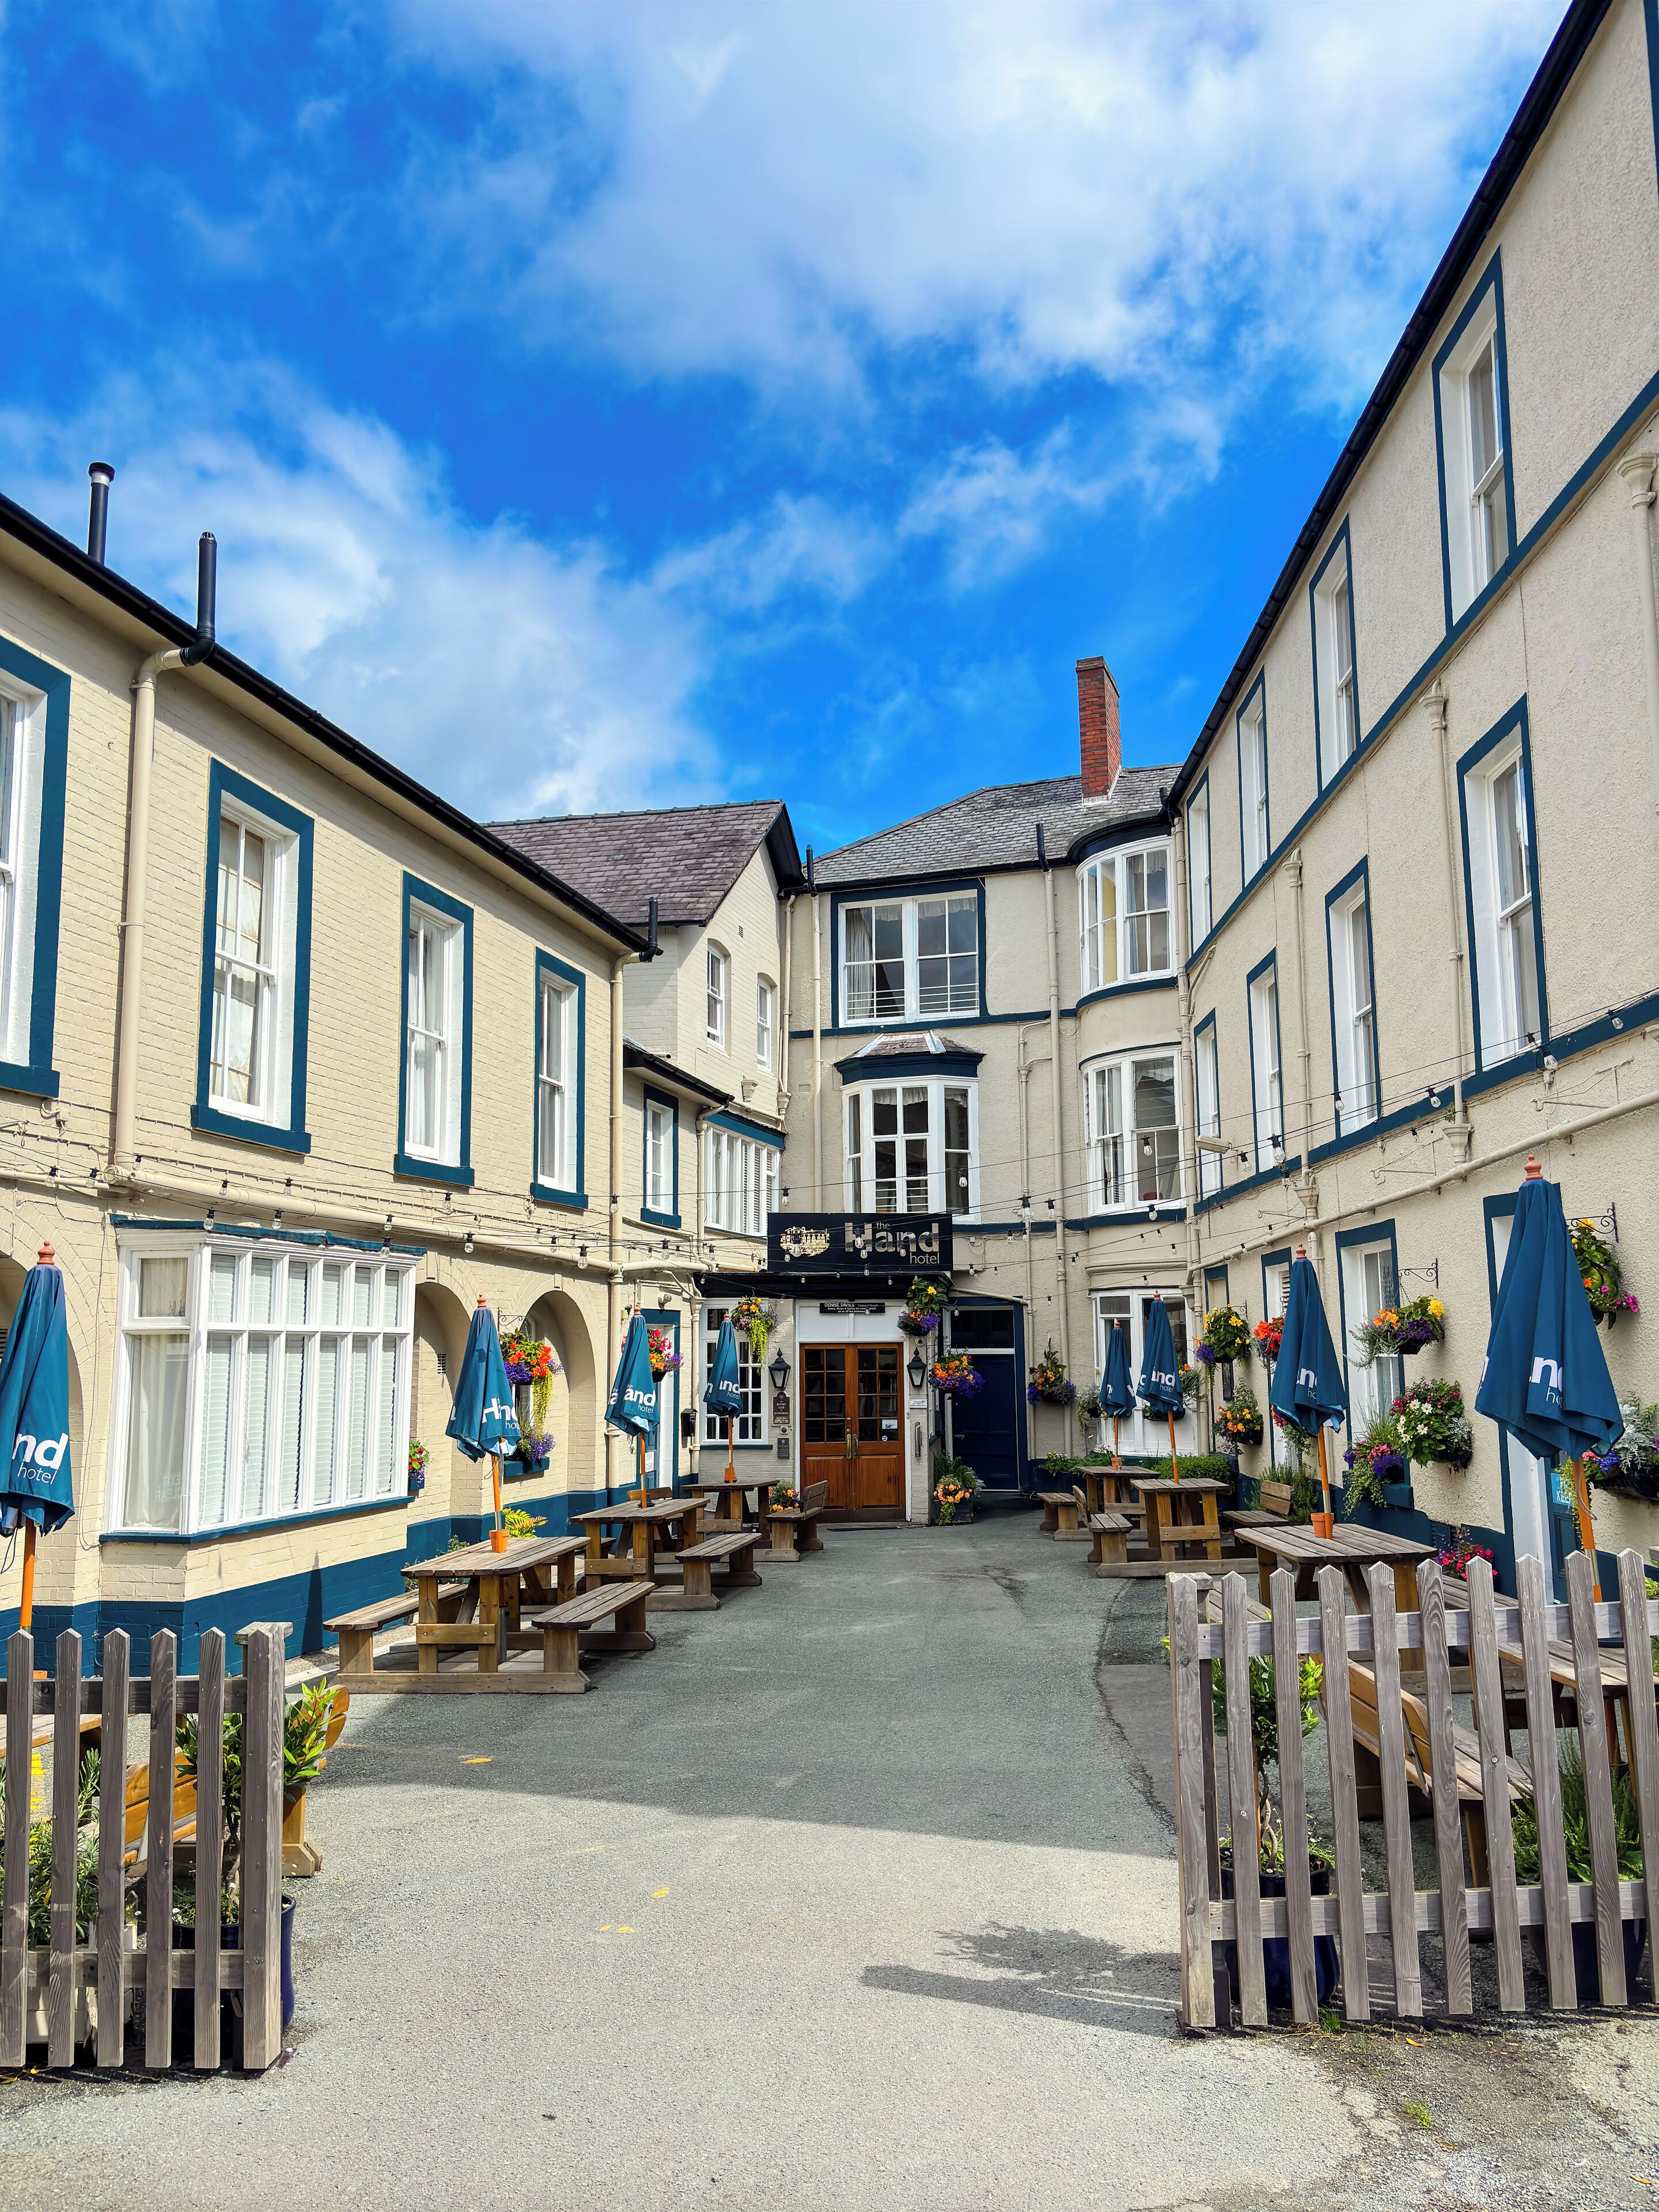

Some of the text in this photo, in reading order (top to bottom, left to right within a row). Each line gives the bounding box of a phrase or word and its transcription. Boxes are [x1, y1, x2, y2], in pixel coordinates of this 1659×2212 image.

[876, 1222, 891, 1230] the
[844, 1222, 940, 1252] Hand
[910, 1252, 940, 1264] hotel
[1160, 1384, 1175, 1392] hotel
[727, 1391, 740, 1399] hotel
[638, 1403, 654, 1414] hotel
[17, 1461, 58, 1485] hotel
